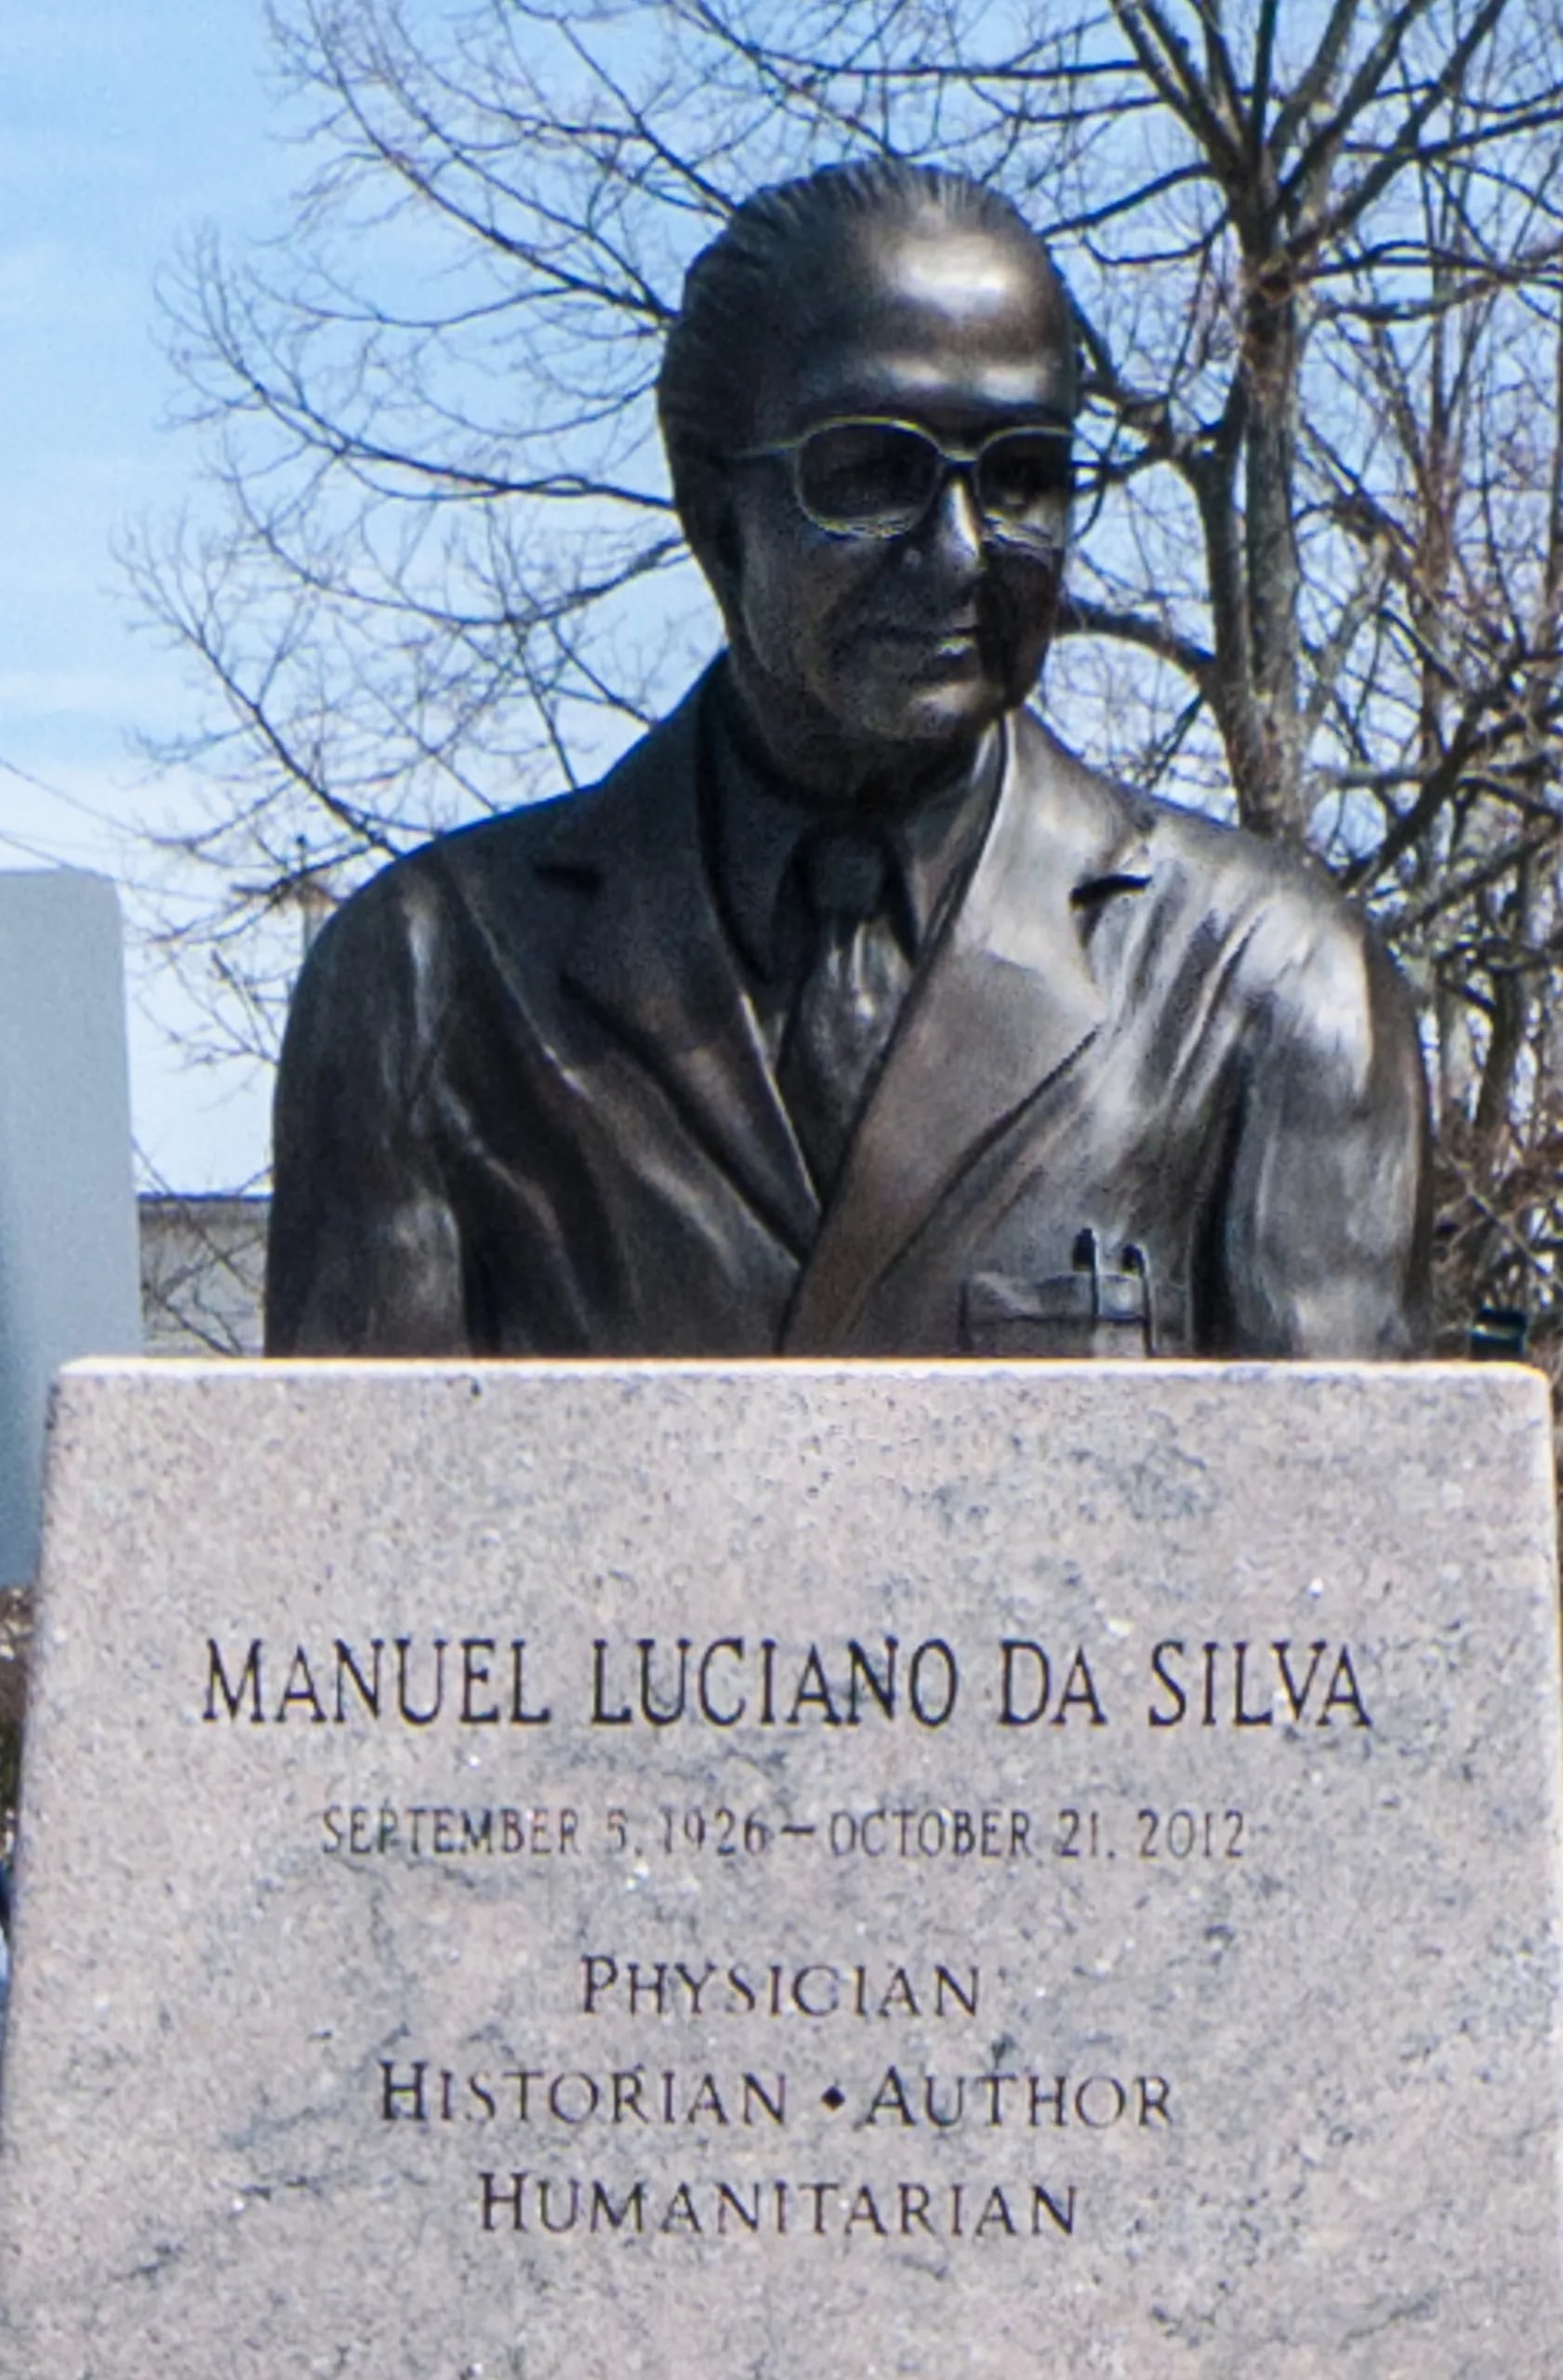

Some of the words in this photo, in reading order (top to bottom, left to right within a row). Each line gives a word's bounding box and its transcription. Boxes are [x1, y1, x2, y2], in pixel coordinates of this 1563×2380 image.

[202, 1637, 551, 1725] MANUEL
[589, 1637, 958, 1727] LUCIANO
[998, 1638, 1108, 1726] DA
[1148, 1640, 1372, 1726] SILVA
[322, 1805, 578, 1855] SEPTEMBER
[1137, 1808, 1245, 1858] 2012
[581, 1955, 979, 2017] PHYSICIAN
[377, 2061, 787, 2125] HISTORIAN
[857, 2066, 1172, 2129] AUTHOR
[478, 2172, 1078, 2237] HUMANITARIAN
